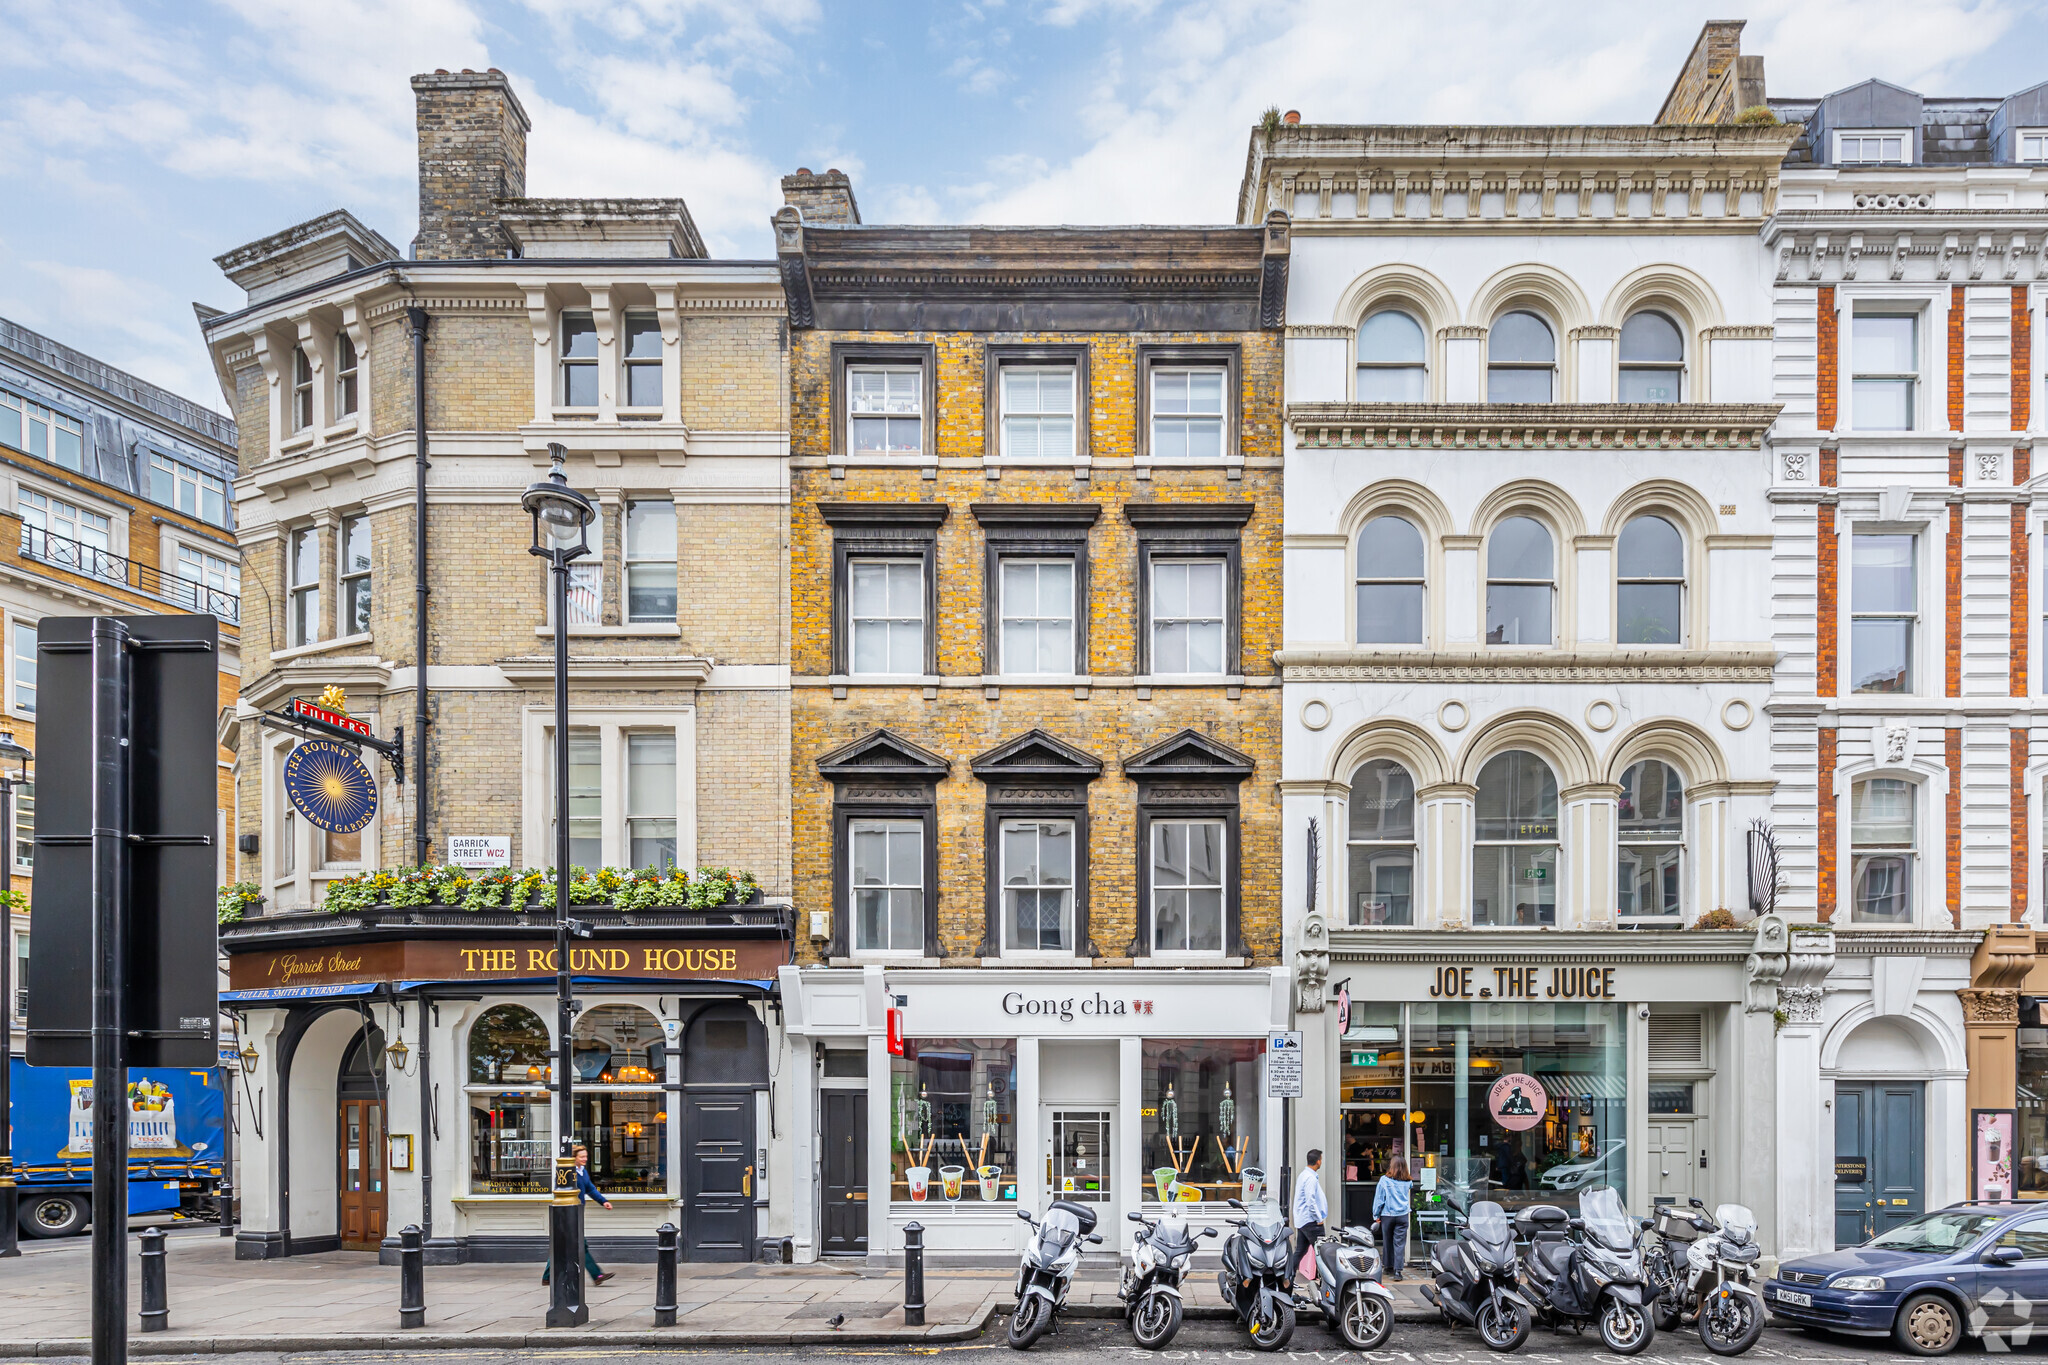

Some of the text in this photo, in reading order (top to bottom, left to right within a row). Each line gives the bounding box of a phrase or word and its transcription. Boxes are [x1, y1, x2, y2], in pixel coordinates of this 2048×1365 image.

[288, 742, 376, 803] THE ROUND HOUSE
[290, 789, 373, 833] COVENT GARDEN
[454, 839, 489, 847] GARRICK
[454, 849, 505, 858] STREET WC2
[268, 951, 362, 983] 1 Garrick Street
[460, 948, 737, 972] THE ROUND HOUSE
[236, 990, 270, 999] FULLER,
[272, 988, 299, 997] SMITH
[309, 986, 344, 994] TURNER
[1430, 966, 1616, 998] JOE & THE JUICE
[1002, 992, 1127, 1022] Gong cha
[1494, 1083, 1505, 1097] JOE
[1525, 1081, 1542, 1097] JUICE
[1794, 1295, 1807, 1305] GRK
